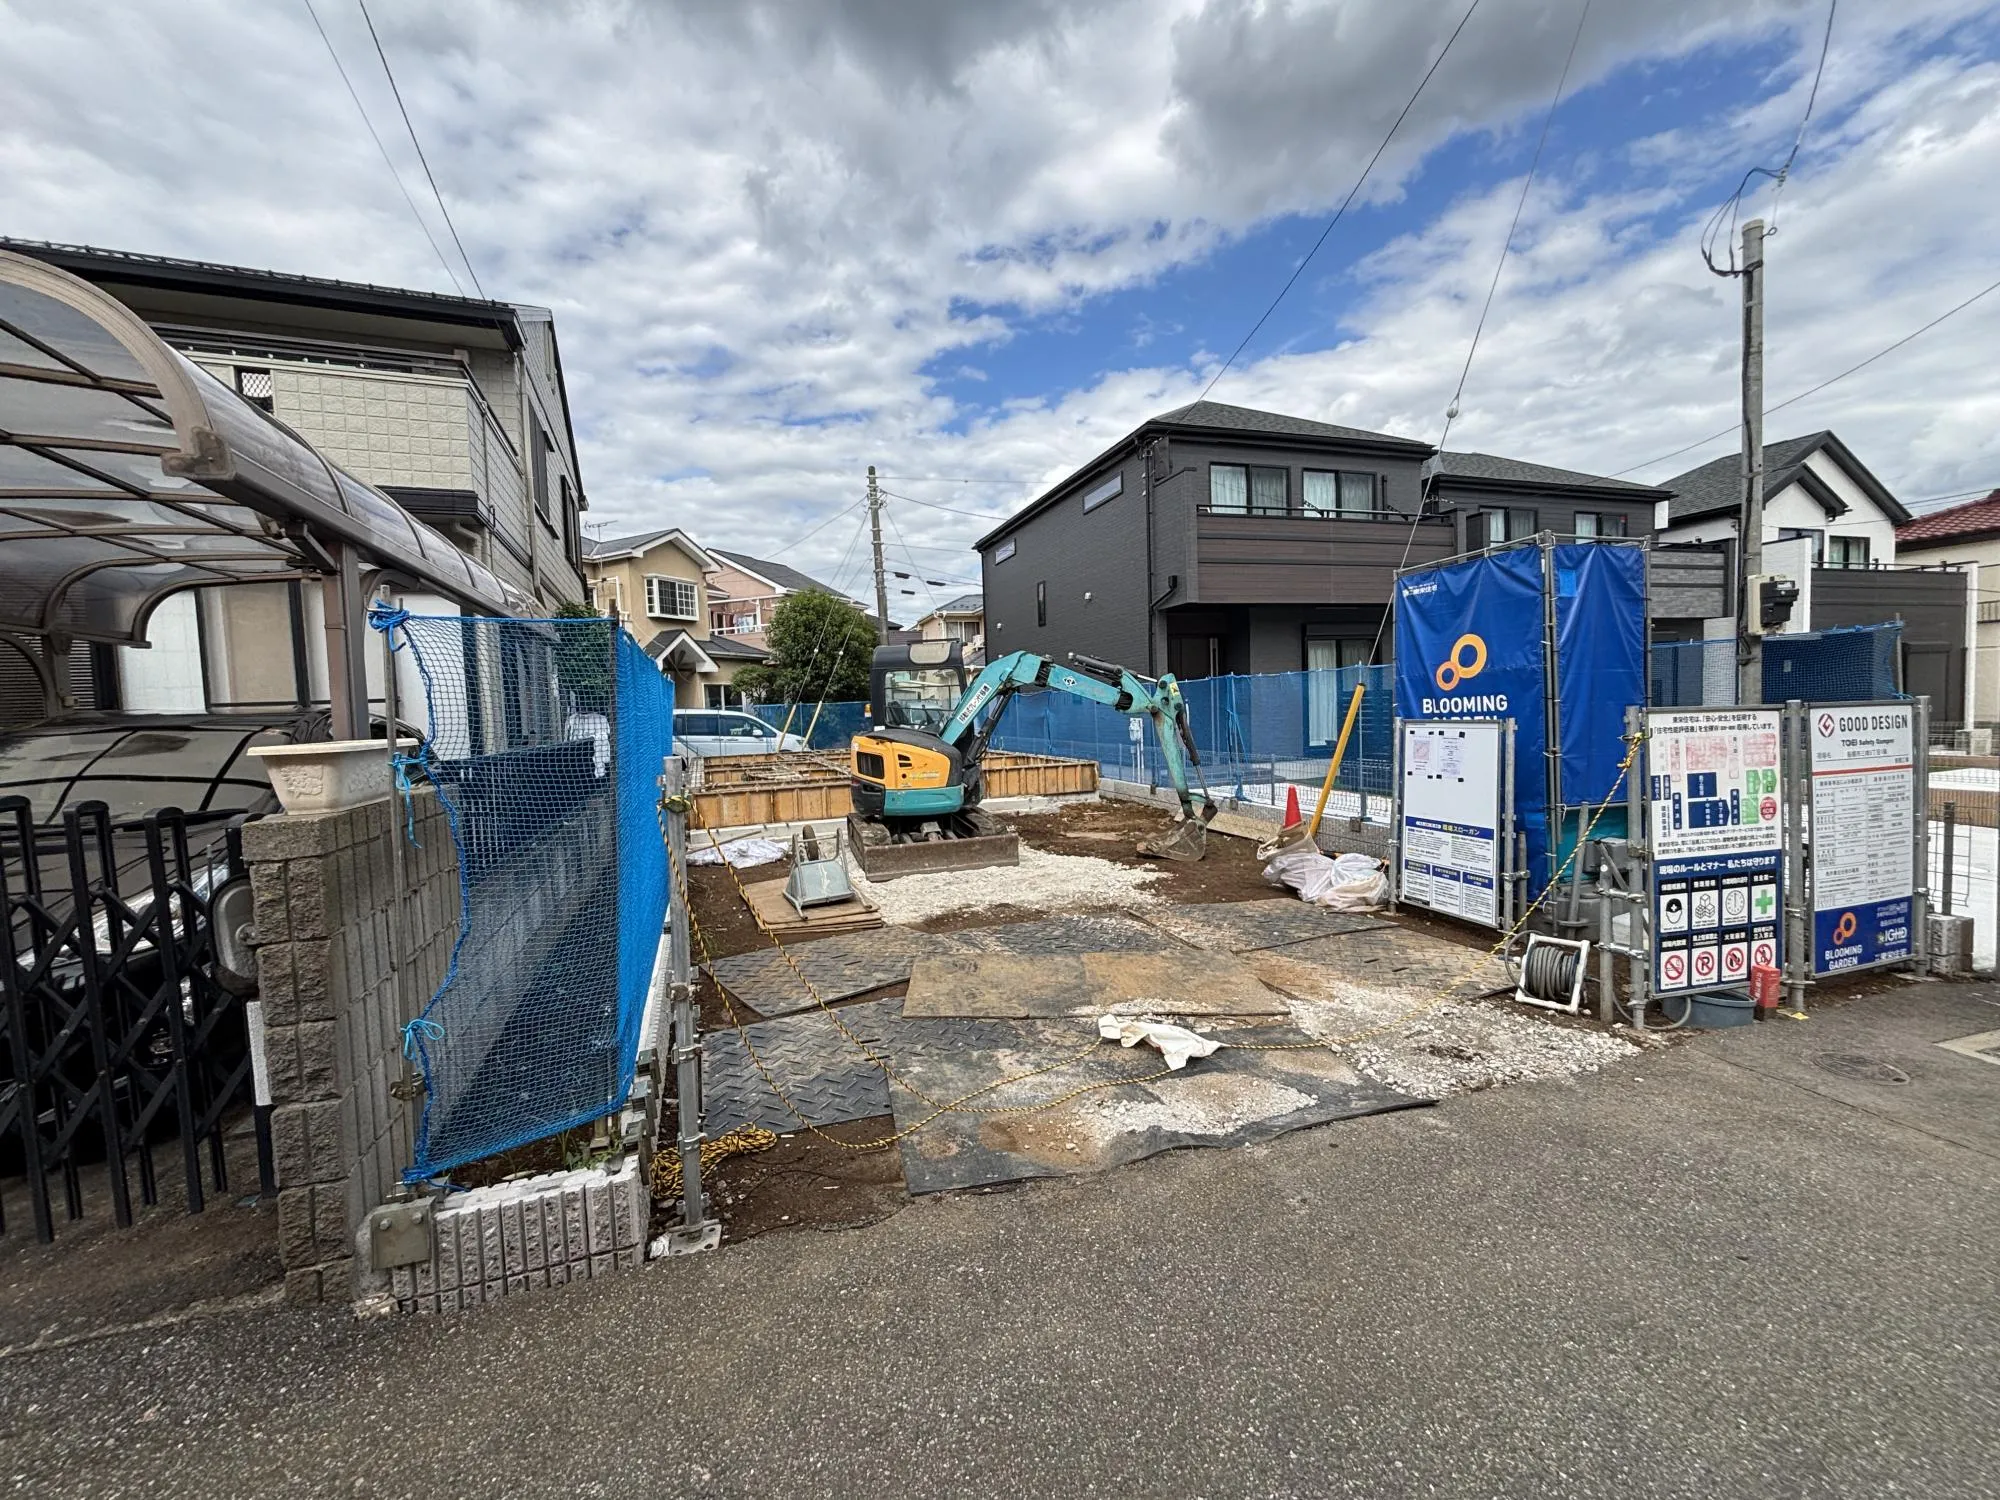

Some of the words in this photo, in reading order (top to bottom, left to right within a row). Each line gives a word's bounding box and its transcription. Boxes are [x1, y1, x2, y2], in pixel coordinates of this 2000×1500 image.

[1422, 695, 1508, 714] BLOOMING
[1839, 717, 1868, 732] GOOD
[1871, 714, 1908, 730] DESIGN
[1659, 862, 1726, 875] 現場のルールとマナー
[1727, 856, 1776, 869] 私たちは守ります
[1824, 945, 1863, 960] BLOOMING
[1828, 956, 1858, 970] GARDEN
